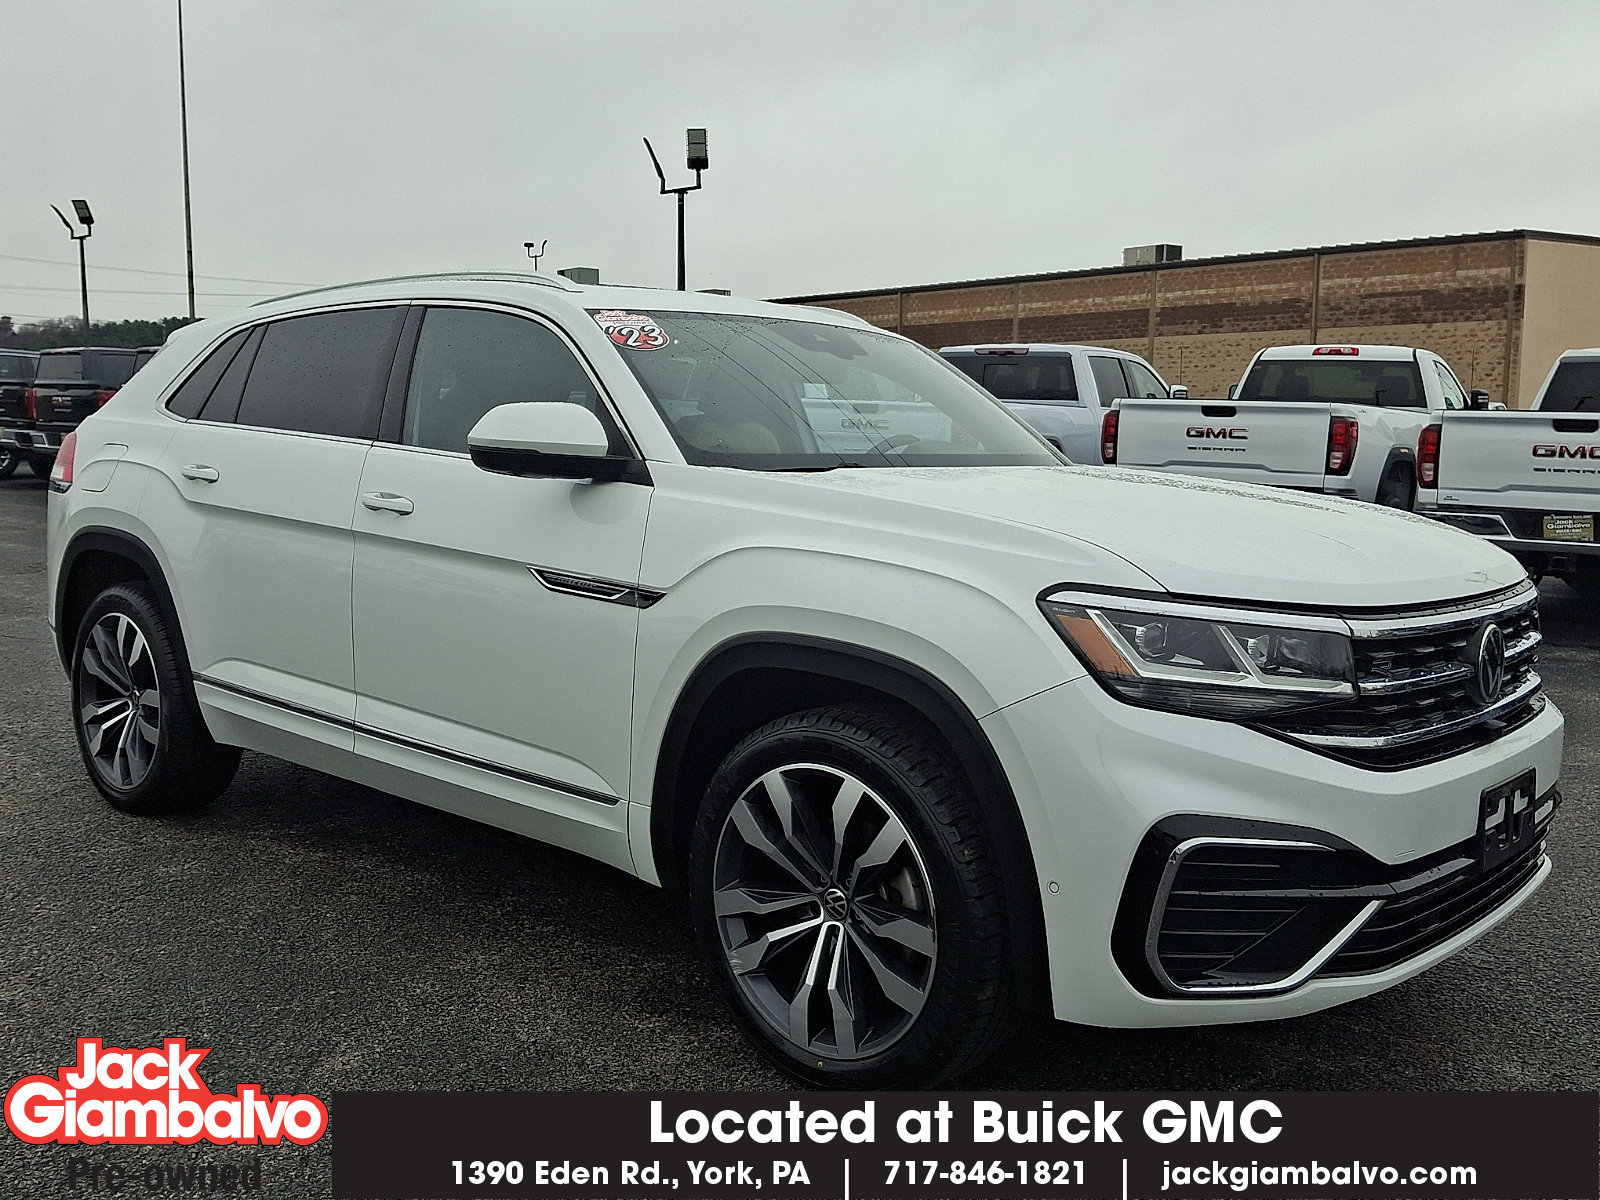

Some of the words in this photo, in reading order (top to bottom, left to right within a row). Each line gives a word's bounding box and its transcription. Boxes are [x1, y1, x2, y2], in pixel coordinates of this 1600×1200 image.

[841, 418, 889, 430] GMC
[1186, 426, 1249, 440] GMC
[1533, 467, 1600, 475] SIERR
